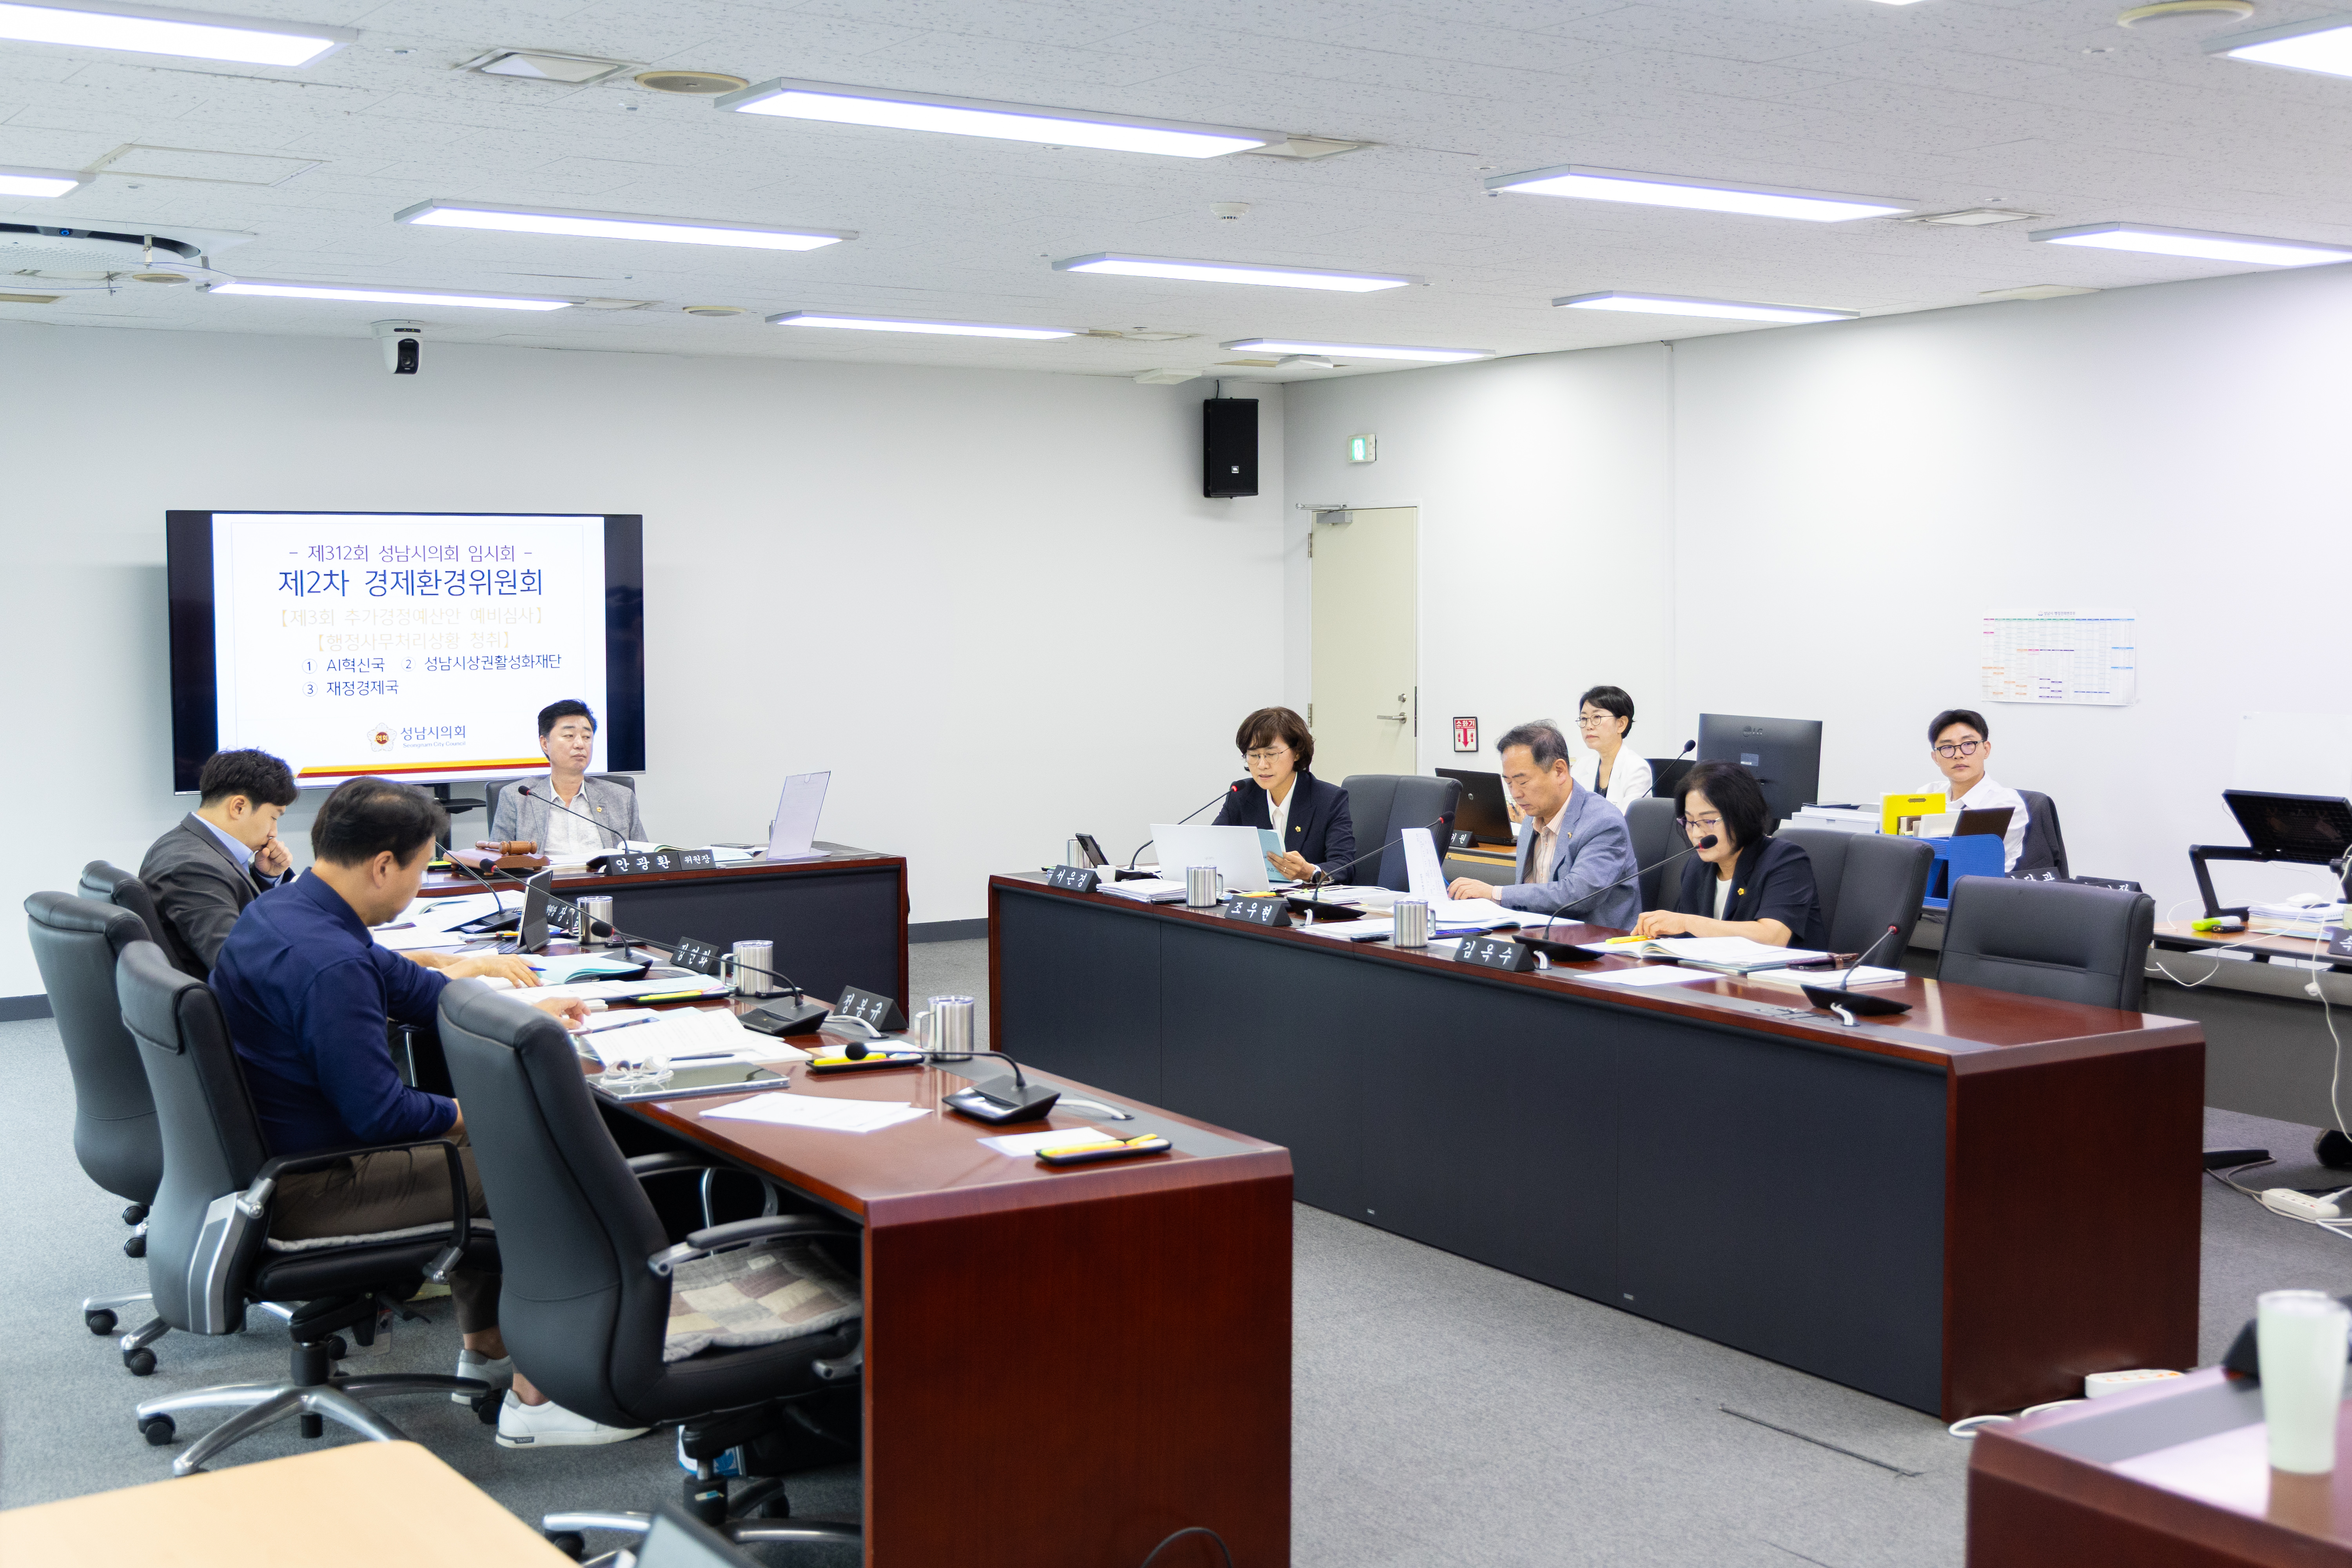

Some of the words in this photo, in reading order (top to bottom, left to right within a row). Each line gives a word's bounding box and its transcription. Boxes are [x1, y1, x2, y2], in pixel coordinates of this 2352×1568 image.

[308, 545, 368, 562] 제312회
[379, 545, 459, 562] 성남시의회
[468, 545, 515, 562] 임시회
[278, 570, 349, 597] 제2차
[365, 569, 542, 596] 경제환경위원회
[345, 608, 461, 626] 추가경정예산안
[327, 658, 385, 673] AI혁신국
[425, 654, 561, 671] 성남시상권활성화재단
[327, 680, 399, 696] 재정경제국
[401, 726, 465, 740] 성남시의회
[684, 855, 710, 864] 위원장
[1056, 869, 1087, 887] 서은경
[1231, 902, 1272, 921] 조우현
[842, 993, 882, 1023] 정봉규
